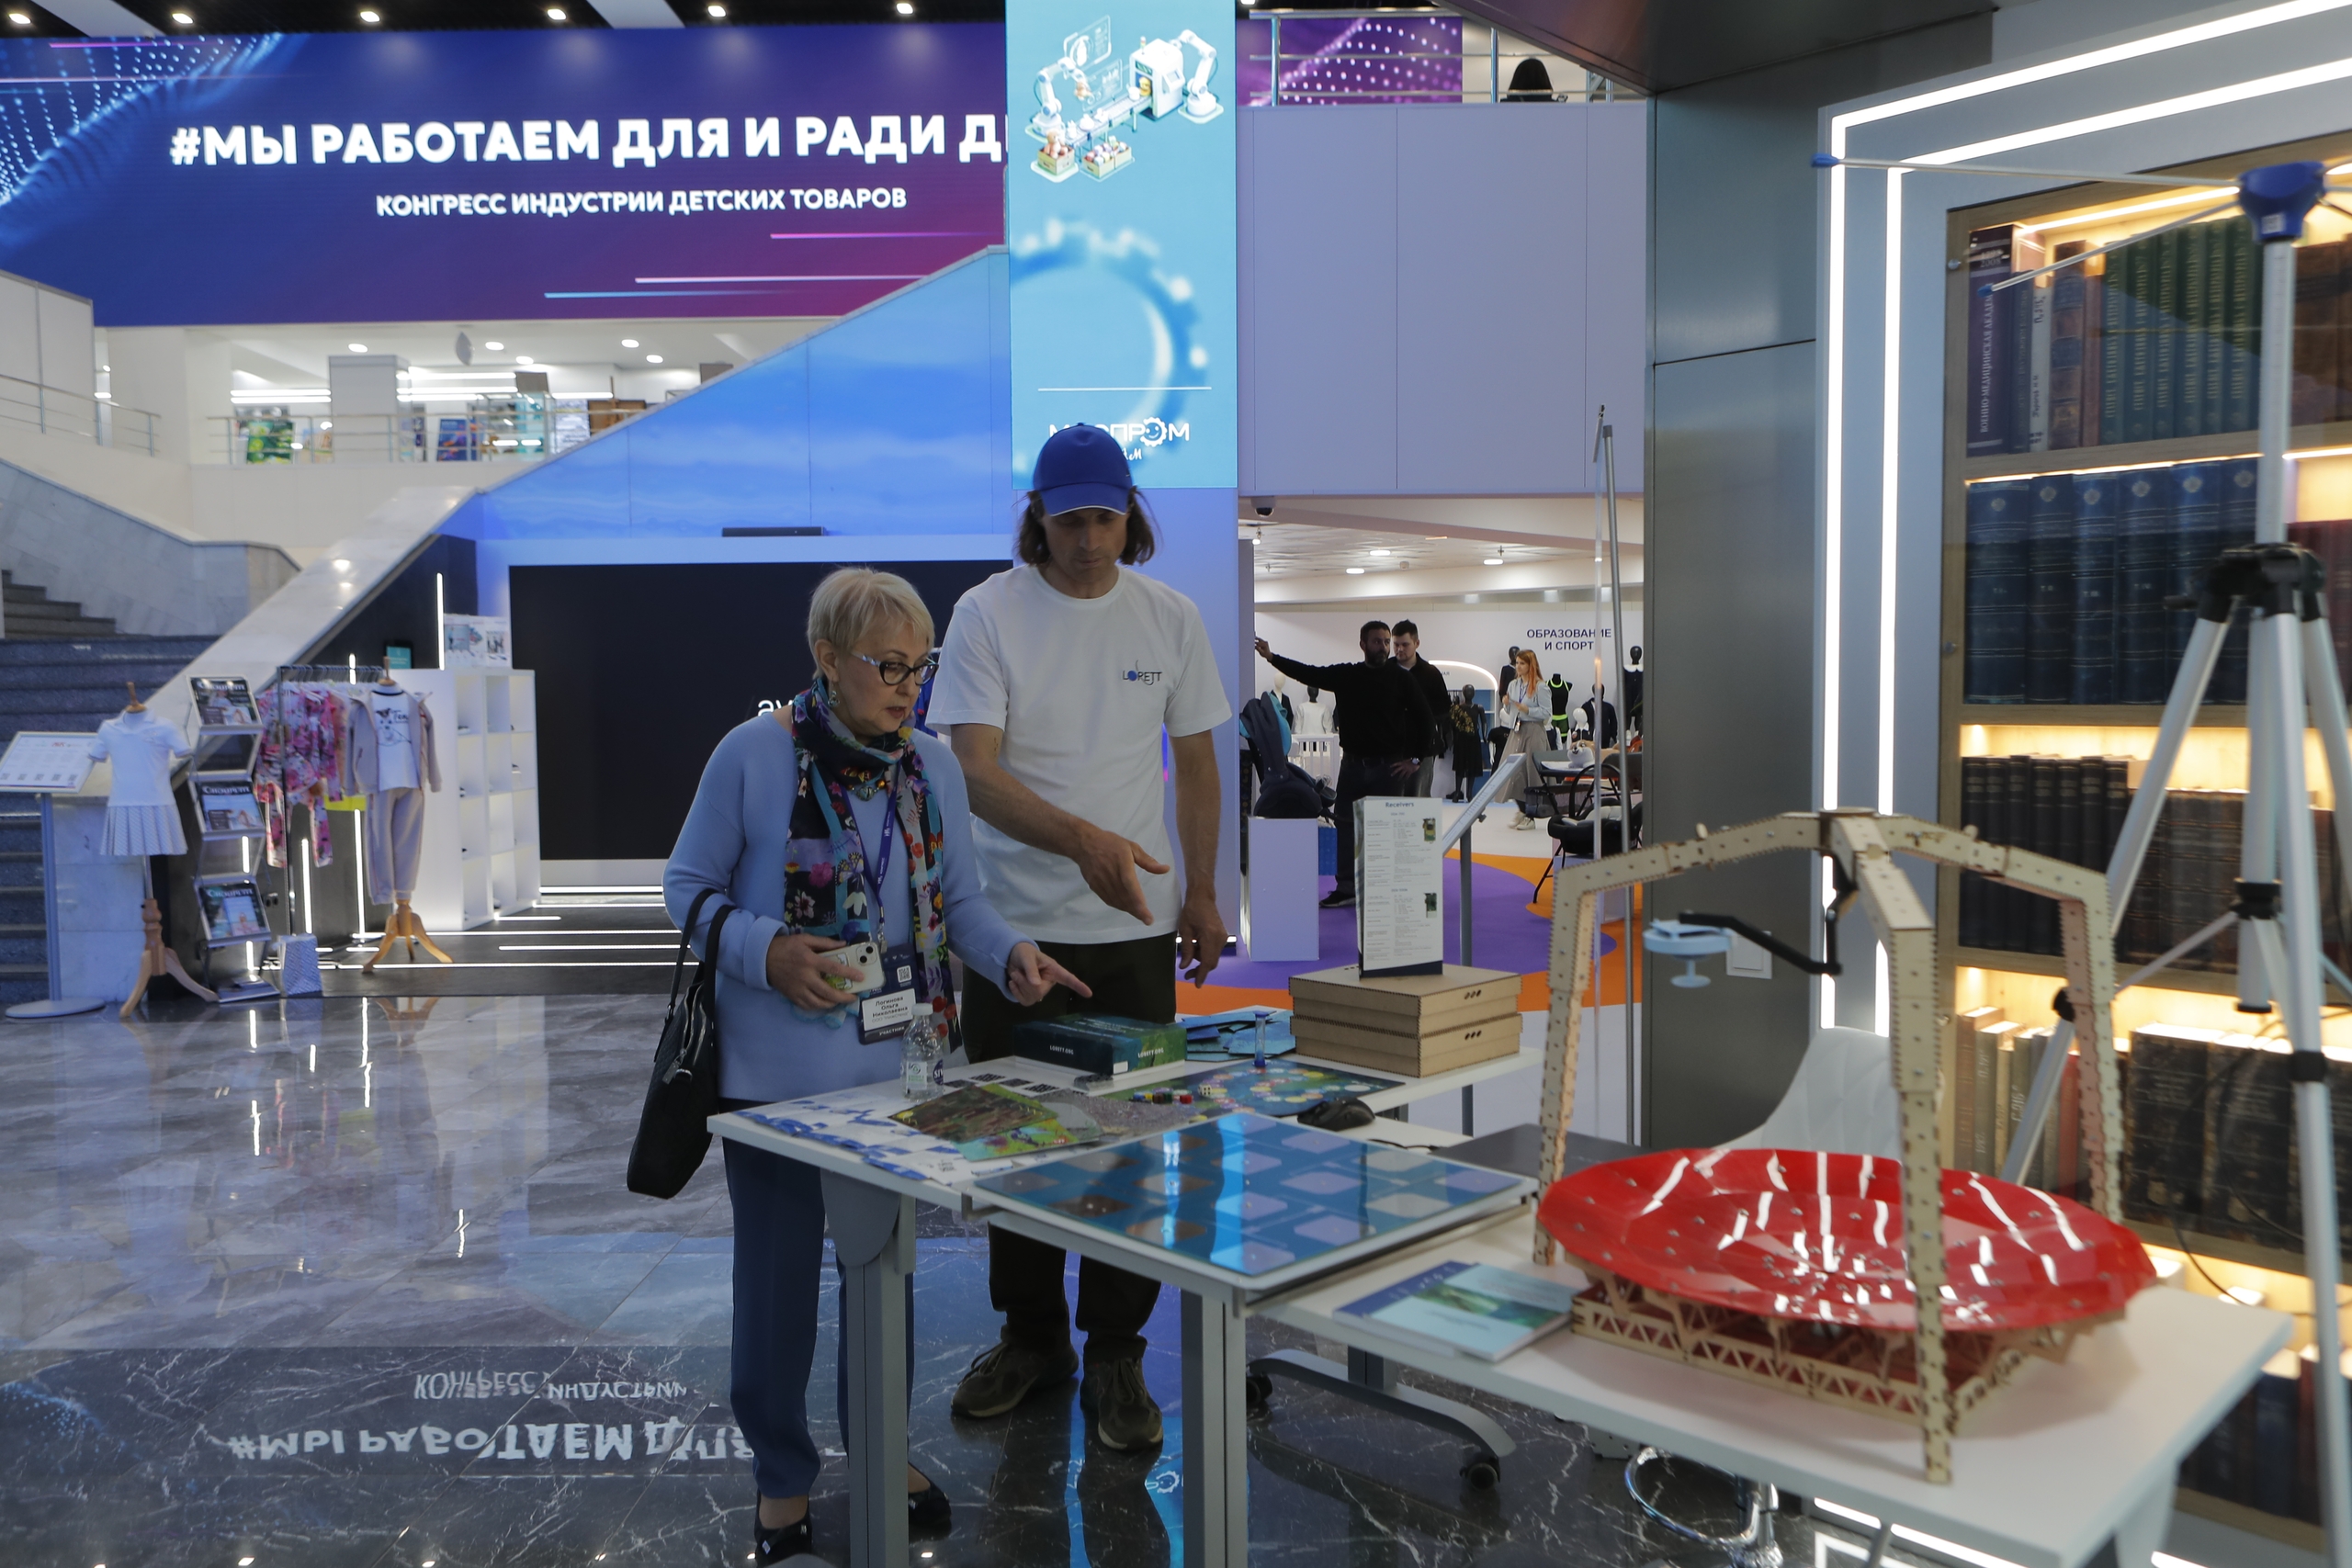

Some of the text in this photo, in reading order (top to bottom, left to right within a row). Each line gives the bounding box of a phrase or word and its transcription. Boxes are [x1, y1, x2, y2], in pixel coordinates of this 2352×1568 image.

[170, 113, 1008, 168] #МЫ РАБОТАЕМ ДЛЯ И РАДИ Д
[376, 186, 908, 217] КОНГРЕСС ИНДУСТРИИ ДЕТСКИХ ТОВАРОВ
[1544, 641, 1594, 650] И СПОРТ
[876, 997, 904, 1007] Логинова
[872, 1007, 909, 1018] Николаевна
[879, 1026, 905, 1036] УЧАСТНИК
